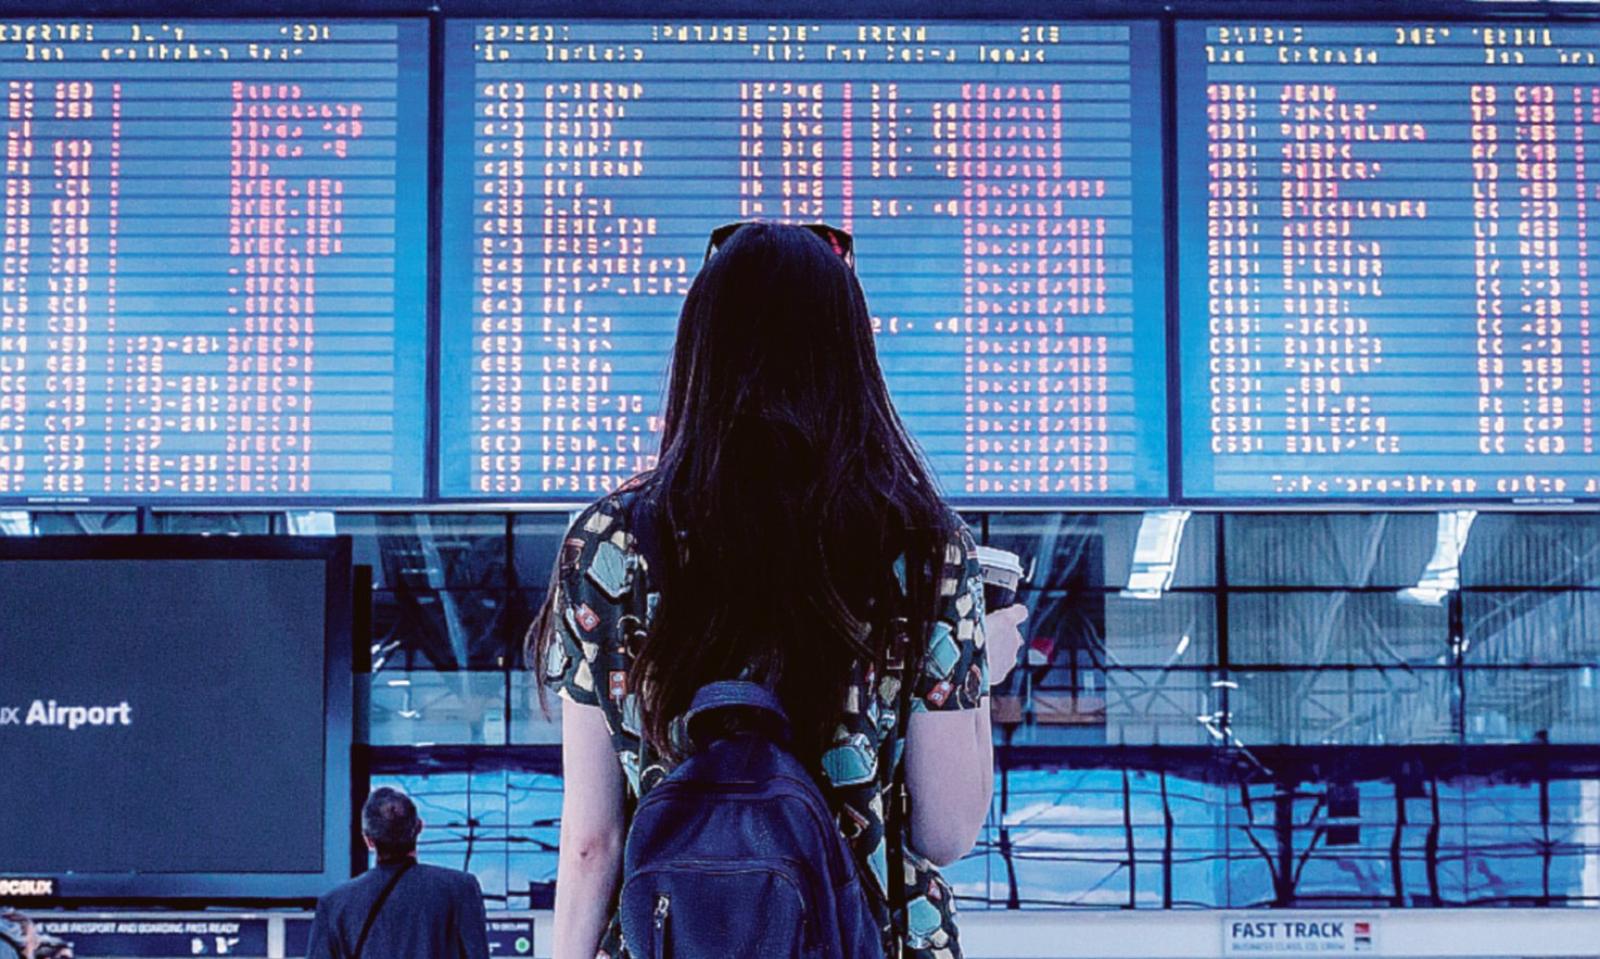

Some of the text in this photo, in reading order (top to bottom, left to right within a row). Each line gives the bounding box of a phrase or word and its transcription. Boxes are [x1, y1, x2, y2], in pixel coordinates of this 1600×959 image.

[25, 699, 132, 730] Airport
[71, 922, 116, 934] PASSPORT
[117, 922, 137, 934] AND
[208, 922, 240, 934] READY
[1232, 922, 1344, 939] FAST TRACK
